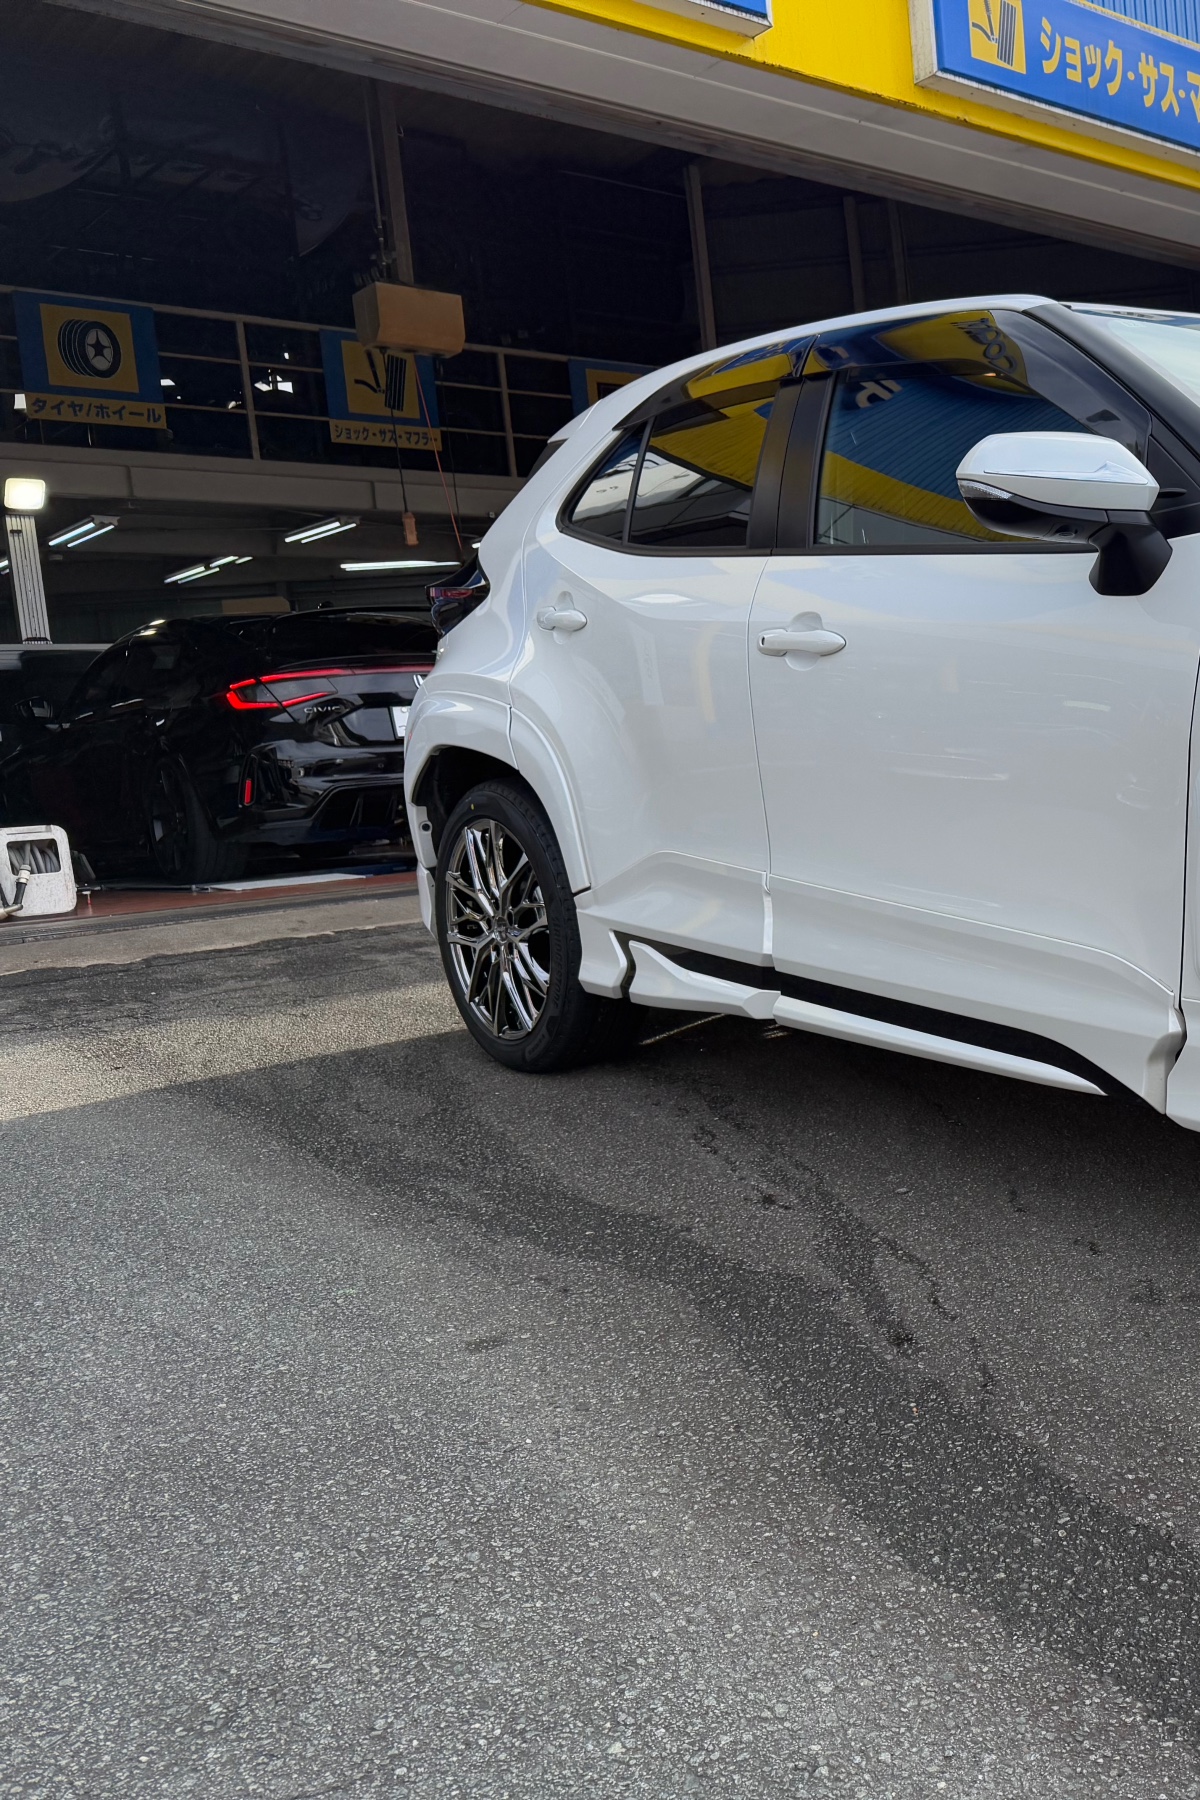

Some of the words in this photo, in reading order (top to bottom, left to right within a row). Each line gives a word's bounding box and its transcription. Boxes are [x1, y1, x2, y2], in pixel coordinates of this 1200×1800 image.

[31, 397, 162, 423] タイヤ/ホイール
[304, 705, 342, 714] CIVIC
